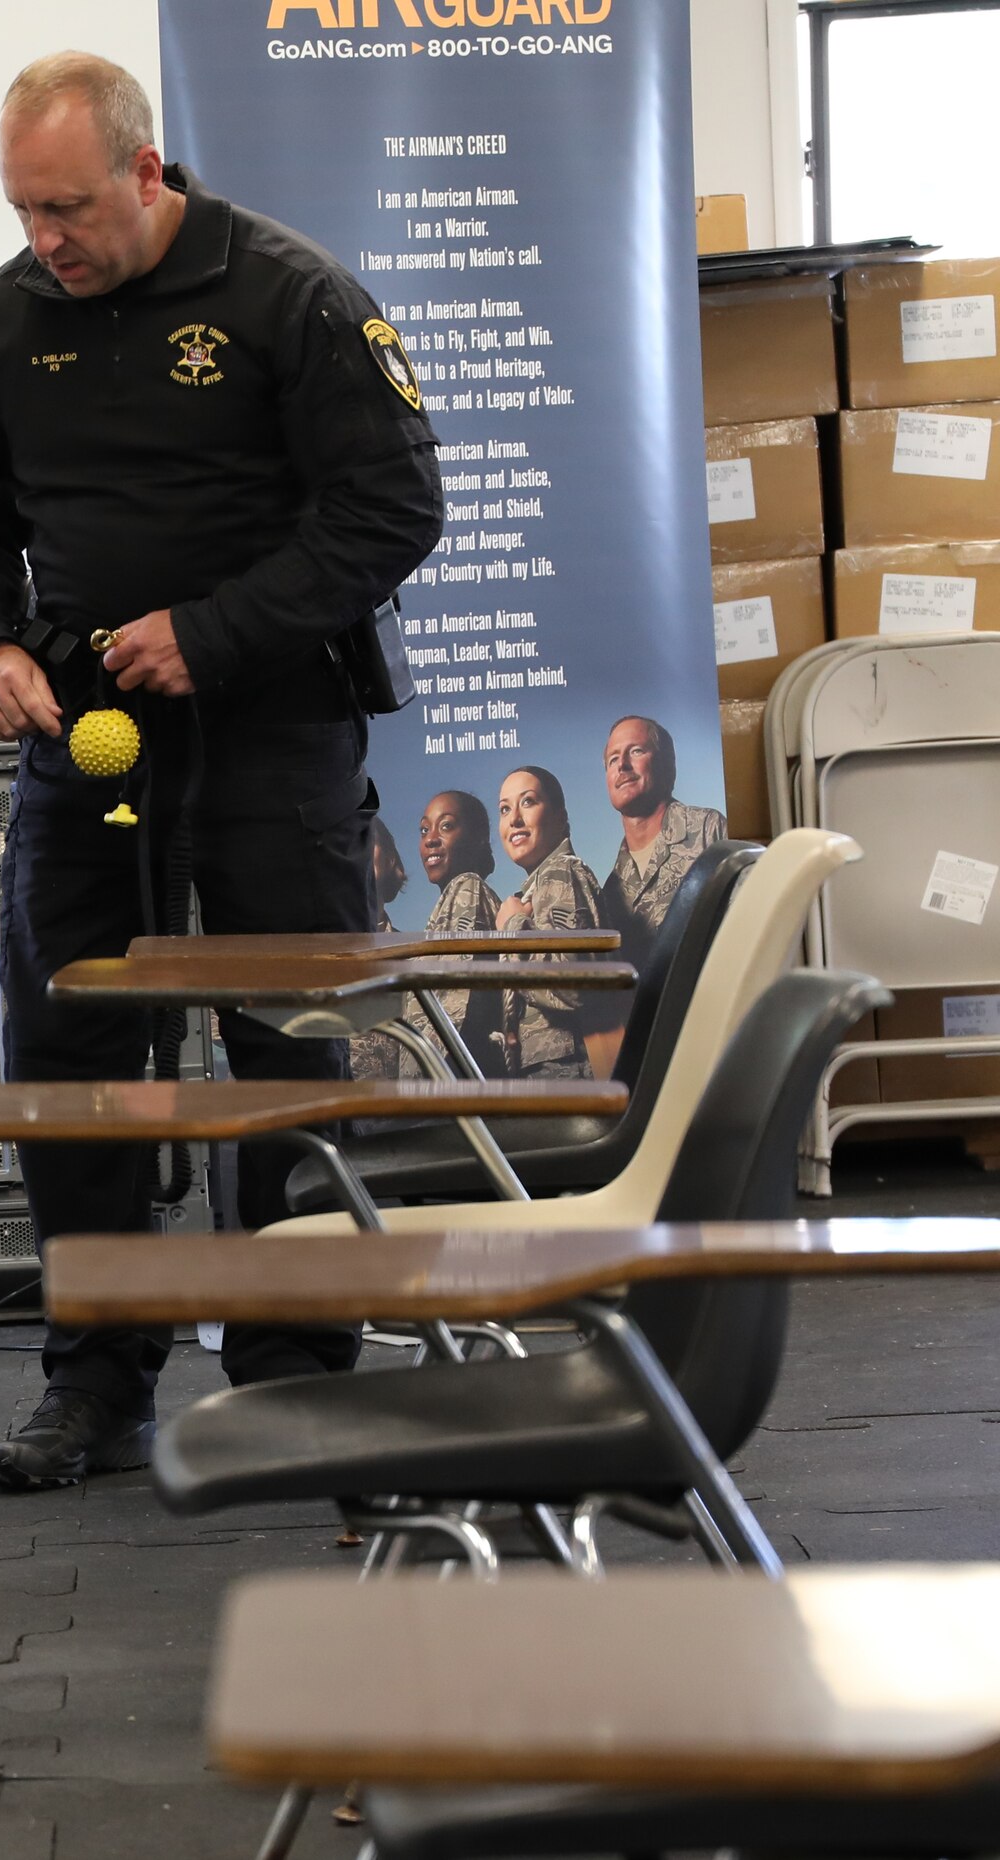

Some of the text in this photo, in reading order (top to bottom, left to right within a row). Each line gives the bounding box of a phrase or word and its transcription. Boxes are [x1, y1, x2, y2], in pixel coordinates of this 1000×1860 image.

[268, 34, 612, 59] GoANG.com 800-TO-GO-ANG
[384, 135, 506, 157] THE AIRMAN'S CREED
[378, 187, 518, 209] I am an American Airman.
[407, 218, 488, 238] I am a Warrior.
[361, 245, 541, 271] I have answered my Nation's call.
[382, 299, 523, 321] I am an American Airman.
[208, 327, 230, 345] COUNTY
[421, 332, 430, 350] is
[434, 333, 444, 350] to
[449, 331, 467, 352] Fly,
[471, 330, 501, 351] Fight,
[505, 328, 525, 347] and
[529, 329, 552, 345] Win.
[32, 357, 40, 365] D.
[50, 363, 60, 371] K9
[435, 363, 445, 380] to
[450, 366, 456, 379] a
[461, 360, 491, 378] Proud
[495, 358, 545, 378] Heritage,
[202, 370, 224, 386] OFFICE
[421, 386, 574, 413] onor, and a Legacy of Valor.
[488, 440, 529, 459] Airman.
[485, 470, 504, 488] and
[509, 468, 551, 489] Justice,
[447, 498, 543, 522] Sword and Shield,
[456, 532, 475, 551] and
[480, 530, 525, 551] Avenger.
[422, 568, 437, 586] my
[441, 563, 482, 584] Country
[486, 560, 508, 579] with
[512, 563, 528, 582] my
[532, 557, 555, 577] Life.
[405, 621, 420, 635] am
[425, 620, 438, 634] an
[442, 612, 492, 632] American
[496, 610, 536, 629] Airman.
[453, 642, 492, 663] Leader,
[495, 639, 538, 658] Warrior.
[437, 674, 465, 693] leave
[469, 676, 482, 691] an
[486, 670, 523, 689] Airman
[528, 666, 567, 687] behind,
[424, 701, 518, 724] I will never falter,
[425, 729, 520, 754] And I will not fail.
